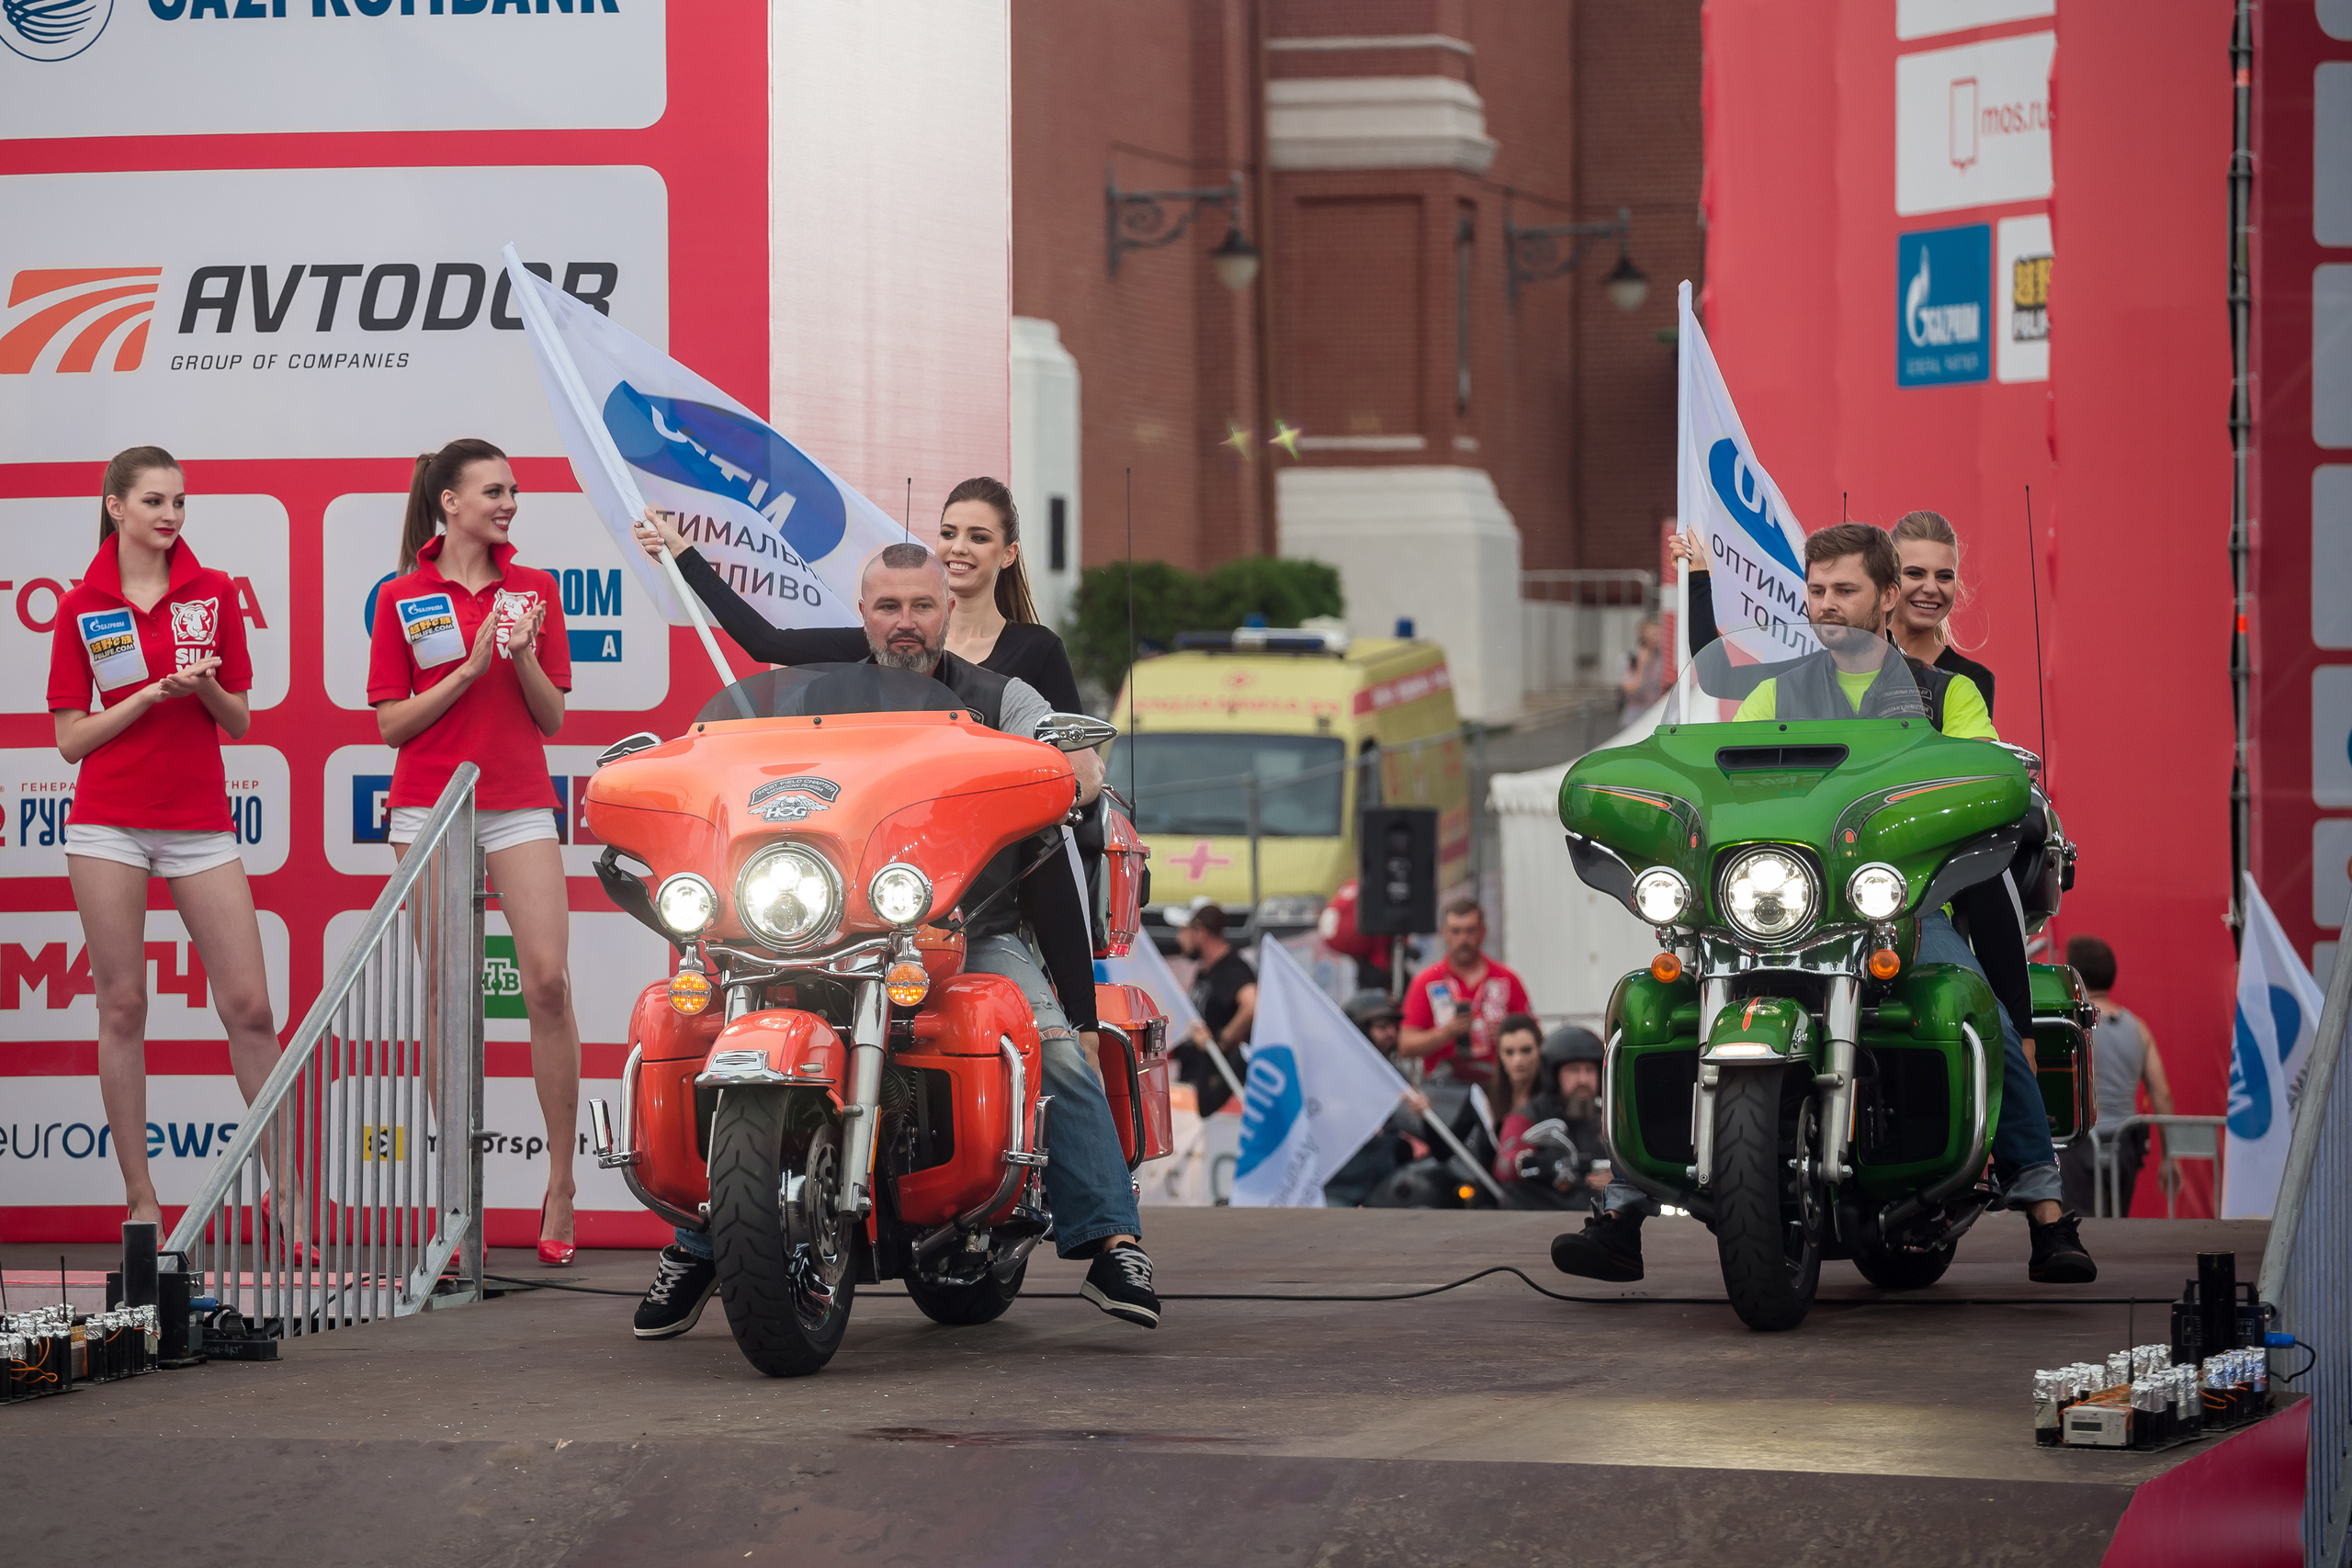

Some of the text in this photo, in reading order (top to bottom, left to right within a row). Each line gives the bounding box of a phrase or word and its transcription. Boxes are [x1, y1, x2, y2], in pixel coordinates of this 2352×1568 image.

[171, 353, 410, 370] GROUP OF COMPANIES
